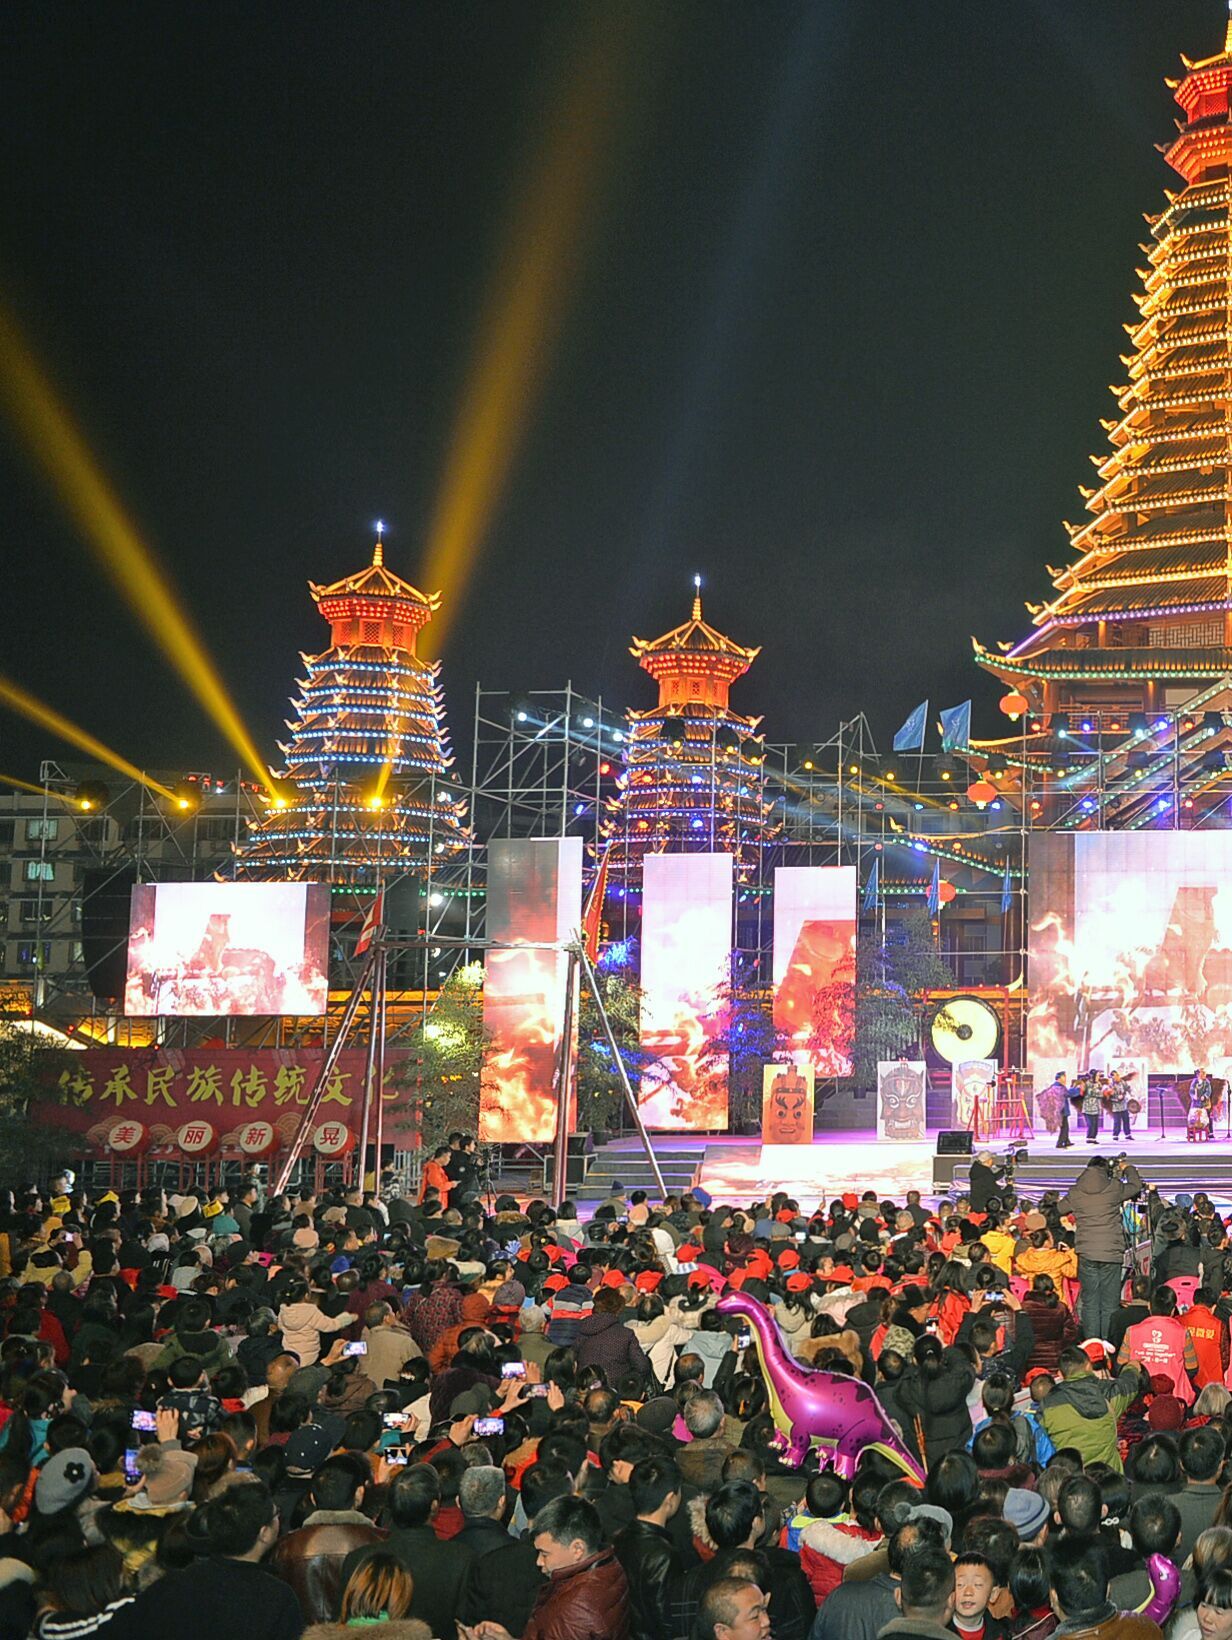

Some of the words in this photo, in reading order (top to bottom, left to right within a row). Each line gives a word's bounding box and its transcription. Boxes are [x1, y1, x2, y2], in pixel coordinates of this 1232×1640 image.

[113, 1126, 137, 1144] 美
[183, 1126, 207, 1144] 丽
[245, 1127, 268, 1145] 新
[319, 1127, 340, 1146] 晃
